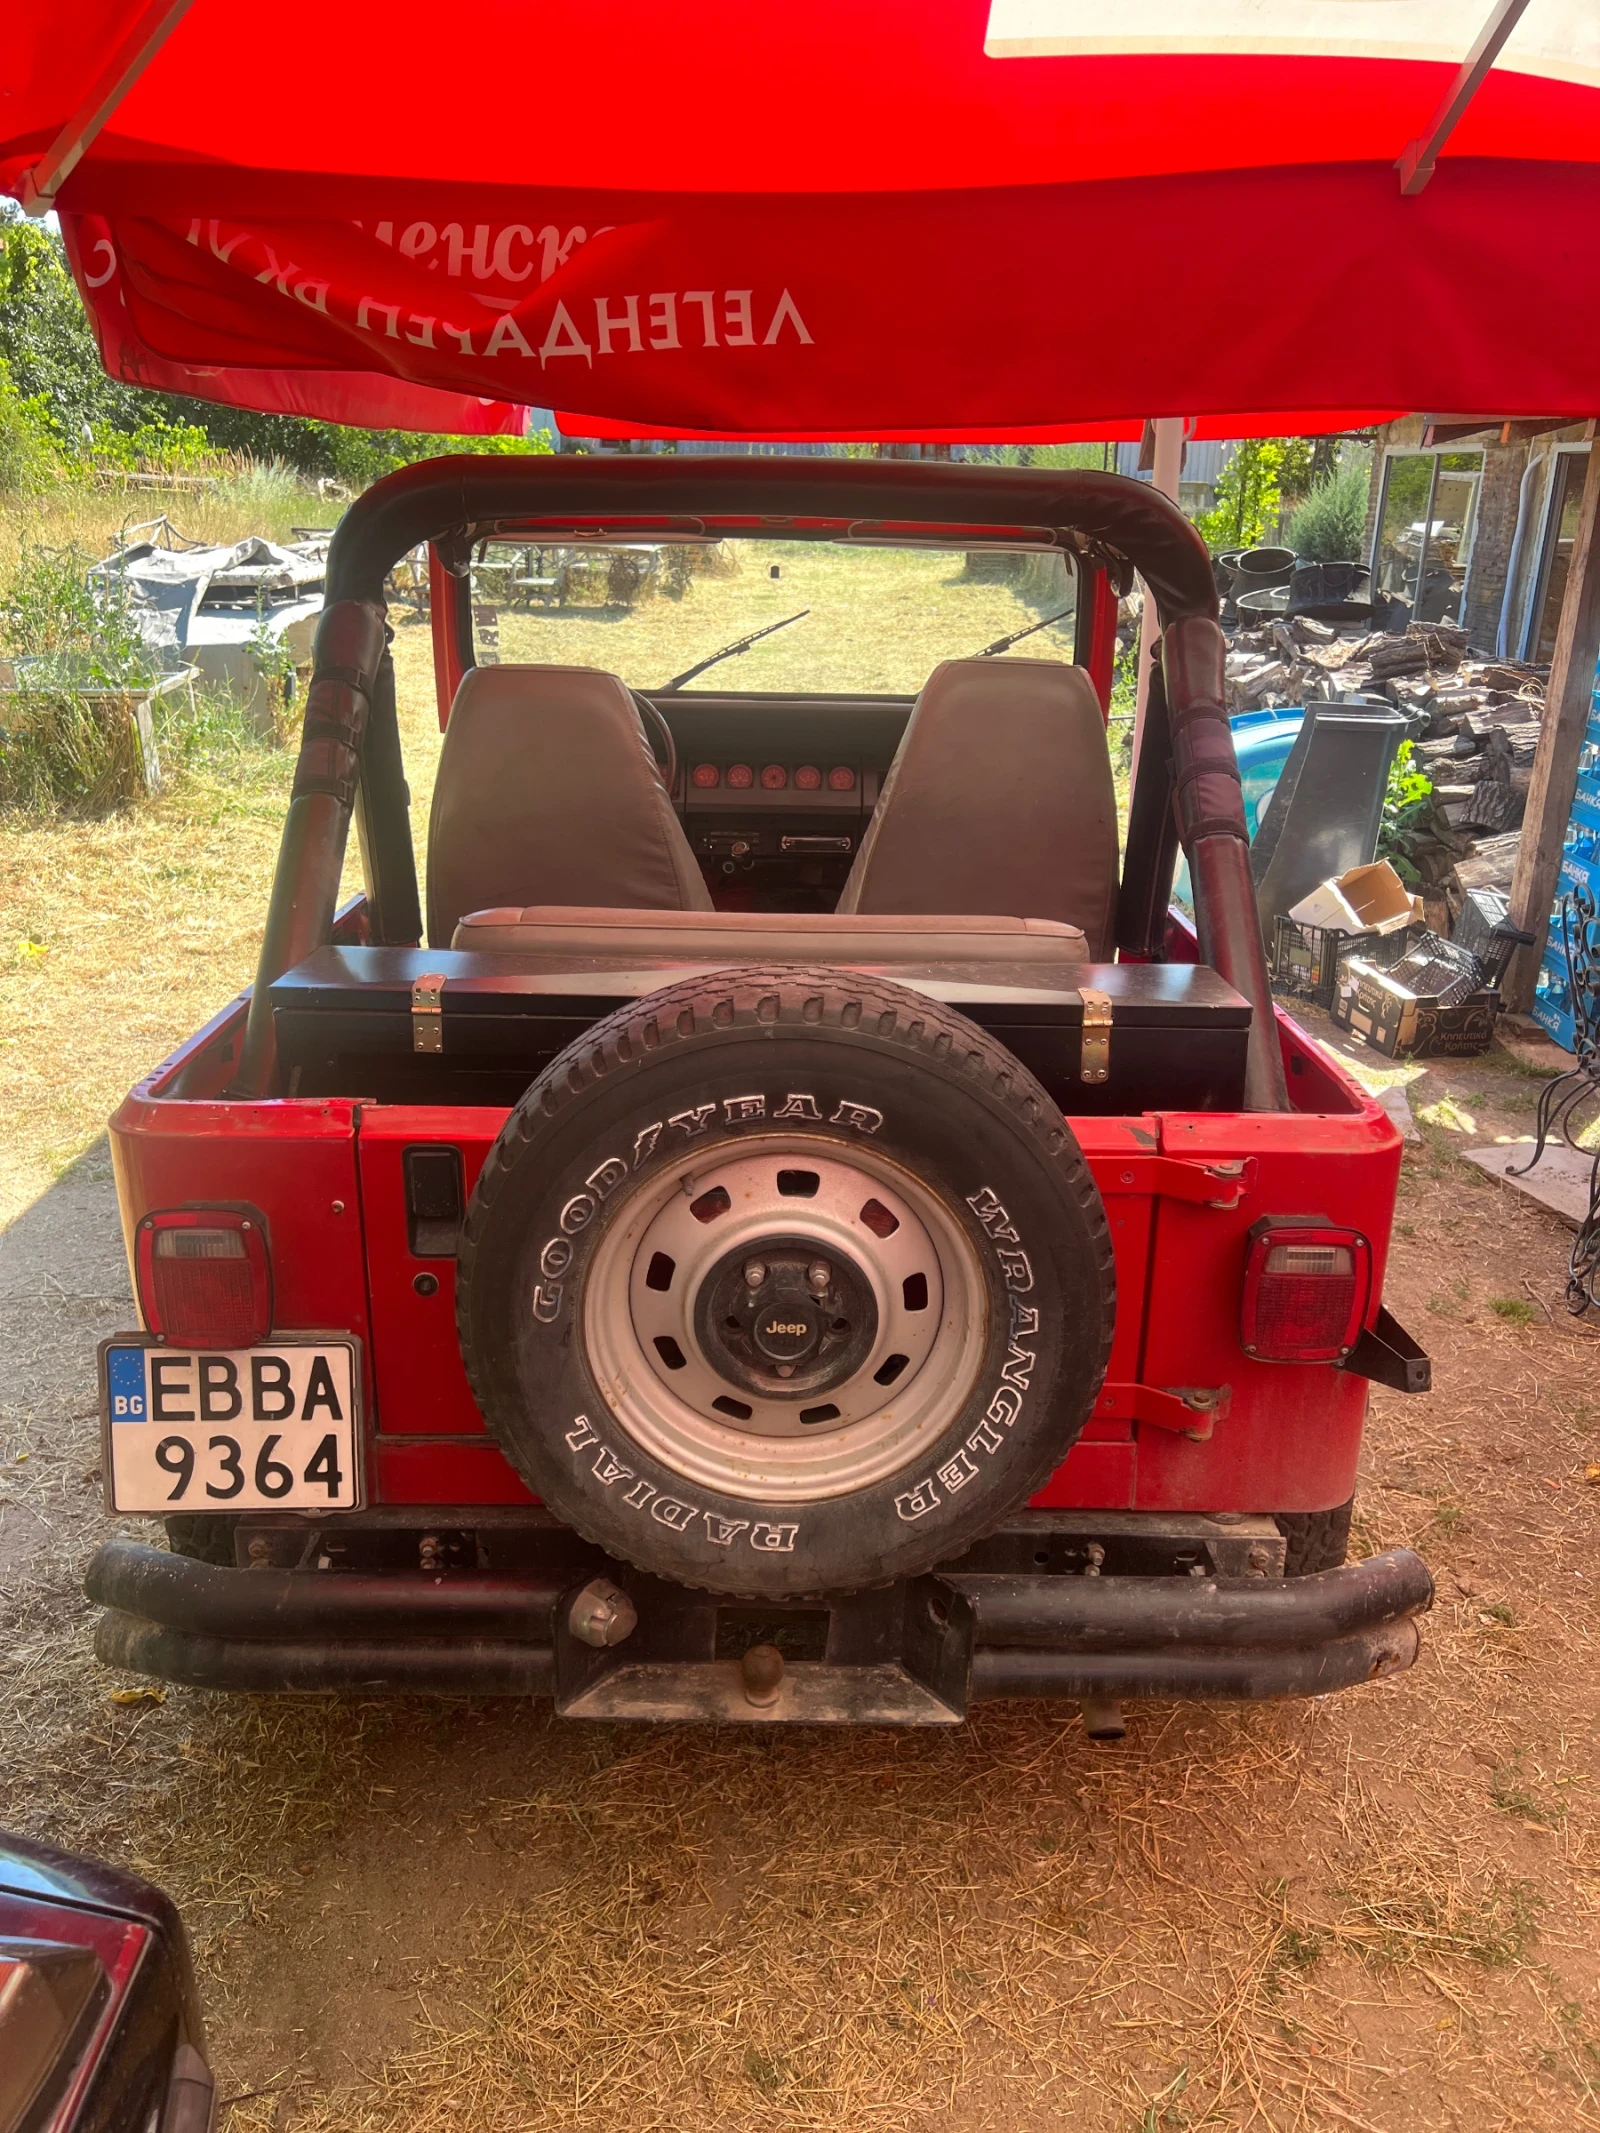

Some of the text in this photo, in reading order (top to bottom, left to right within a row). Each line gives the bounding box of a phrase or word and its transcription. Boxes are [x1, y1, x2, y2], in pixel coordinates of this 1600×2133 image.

[1561, 859, 1590, 884] БАНКЯ
[1532, 1005, 1561, 1033] БАНКЯ
[532, 1093, 885, 1324] GOODYEAR
[765, 1320, 808, 1337] Jeep
[894, 1184, 1040, 1523] WRANGLER
[114, 1396, 143, 1416] BG
[151, 1355, 343, 1422] EBBA
[155, 1434, 343, 1500] 9364
[564, 1414, 800, 1553] RADIAL
